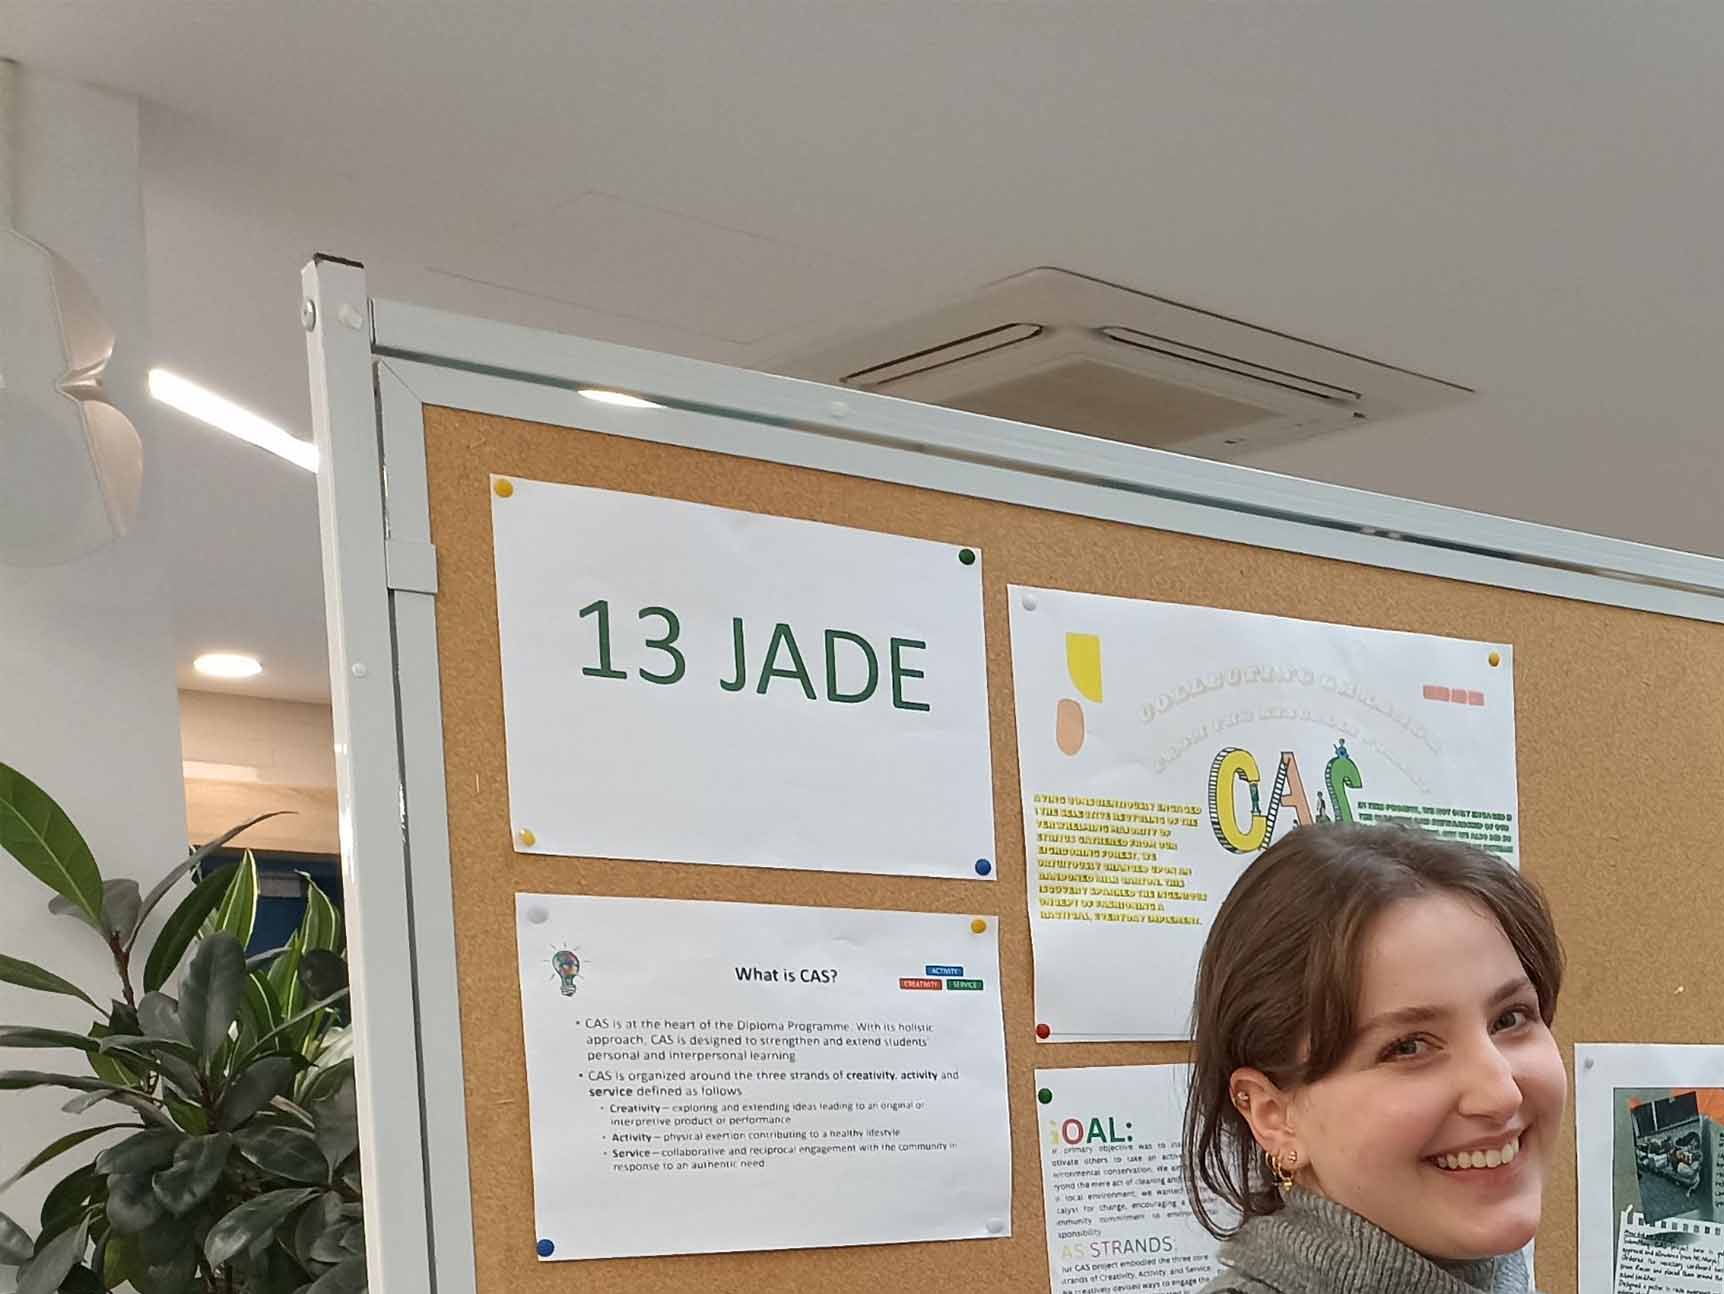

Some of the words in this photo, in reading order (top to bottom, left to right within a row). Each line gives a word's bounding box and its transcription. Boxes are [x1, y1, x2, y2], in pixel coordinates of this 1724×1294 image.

[579, 599, 686, 685] 13
[719, 616, 931, 712] JADE
[735, 967, 779, 982] What
[784, 969, 796, 982] is
[801, 969, 838, 983] CAS?
[585, 1018, 609, 1029] CAS
[613, 1019, 622, 1029] is
[626, 1019, 636, 1029] at
[641, 1019, 660, 1030] the
[665, 1019, 695, 1030] heart
[700, 1019, 711, 1030] of
[715, 1020, 734, 1030] the
[737, 1020, 784, 1032] Diploma
[899, 1023, 934, 1032] holistic
[651, 1035, 673, 1045] CAS
[678, 1035, 686, 1045] is
[690, 1035, 742, 1048] designed
[746, 1036, 757, 1045] to
[760, 1036, 820, 1048] strengthen
[823, 1037, 843, 1046] and
[846, 1037, 880, 1047] extend
[588, 1050, 639, 1061] personal
[643, 1051, 665, 1060] and
[669, 1051, 746, 1062] interpersonal
[588, 1071, 612, 1081] CAS
[616, 1071, 624, 1081] is
[628, 1071, 685, 1083] organized
[690, 1071, 731, 1081] around
[734, 1071, 752, 1080] the
[757, 1071, 786, 1080] three
[790, 1071, 830, 1080] strands
[833, 1070, 843, 1080] of
[901, 1071, 937, 1081] activity
[941, 1071, 959, 1080] and
[589, 1087, 633, 1097] service
[637, 1086, 682, 1096] defined
[686, 1088, 698, 1096] as
[610, 1104, 660, 1113] Creativity
[672, 1104, 718, 1114] exploring
[722, 1103, 739, 1112] and
[743, 1103, 790, 1113] extending
[793, 1102, 816, 1111] ideas
[819, 1102, 853, 1112] leading
[856, 1102, 865, 1110] to
[881, 1101, 913, 1111] original
[610, 1117, 670, 1127] interpretive
[674, 1117, 712, 1126] product
[729, 1116, 791, 1126] performance
[612, 1133, 651, 1143] Activity
[663, 1132, 703, 1142] physical
[706, 1132, 745, 1141] exertion
[748, 1130, 807, 1140] contributing
[810, 1129, 819, 1138] to
[830, 1129, 863, 1139] healthy
[612, 1148, 650, 1158] Service
[661, 1146, 725, 1157] collaborative
[728, 1146, 746, 1156] and
[800, 1144, 856, 1155] engagement
[859, 1144, 879, 1152] with
[881, 1143, 896, 1151] the
[899, 1143, 947, 1153] community
[614, 1162, 660, 1172] response
[663, 1161, 674, 1170] to
[676, 1162, 689, 1170] an
[691, 1160, 737, 1170] authentic
[1090, 1236, 1172, 1258] STRANDS
